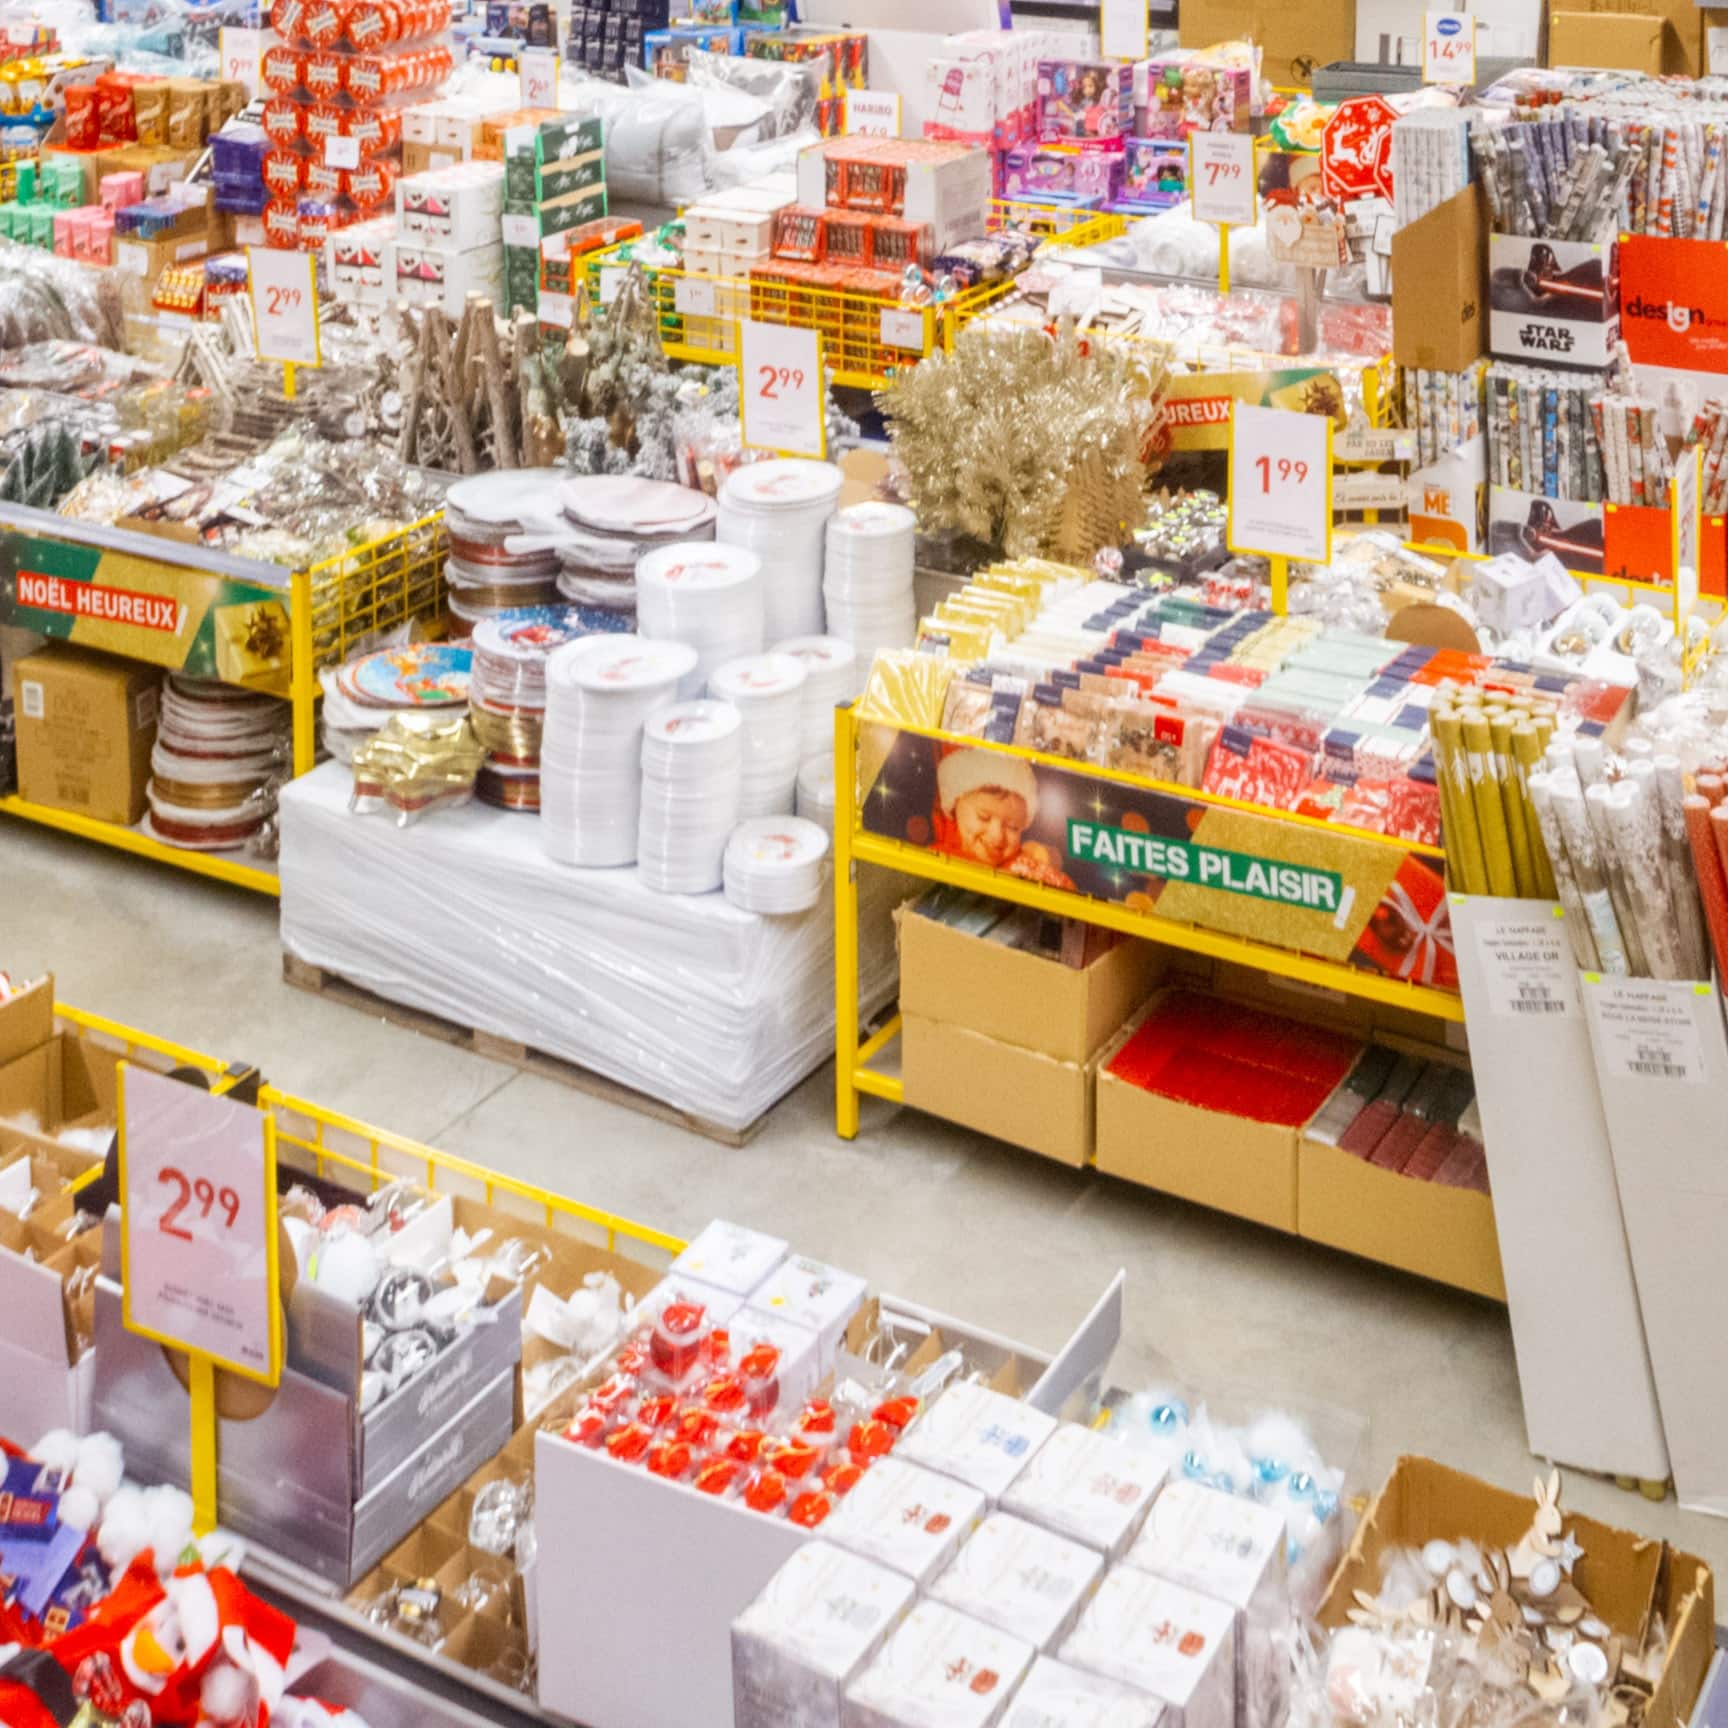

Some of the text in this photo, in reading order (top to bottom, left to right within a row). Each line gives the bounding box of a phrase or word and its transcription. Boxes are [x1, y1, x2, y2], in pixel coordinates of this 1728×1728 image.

[1429, 39, 1473, 60] 1499
[853, 104, 892, 115] HARIBO
[1203, 161, 1241, 186] 799
[266, 286, 302, 316] 299
[1626, 296, 1706, 333] design
[1519, 324, 1572, 339] STAR
[1520, 336, 1574, 352] WARS
[758, 364, 805, 400] 299
[1254, 454, 1309, 495] 199
[1423, 487, 1451, 515] ME
[18, 572, 175, 628] NOËL HEUREUX
[1072, 823, 1337, 910] FAITES PLAISIR
[1496, 951, 1541, 962] VILLAGE
[157, 1166, 241, 1243] 299
